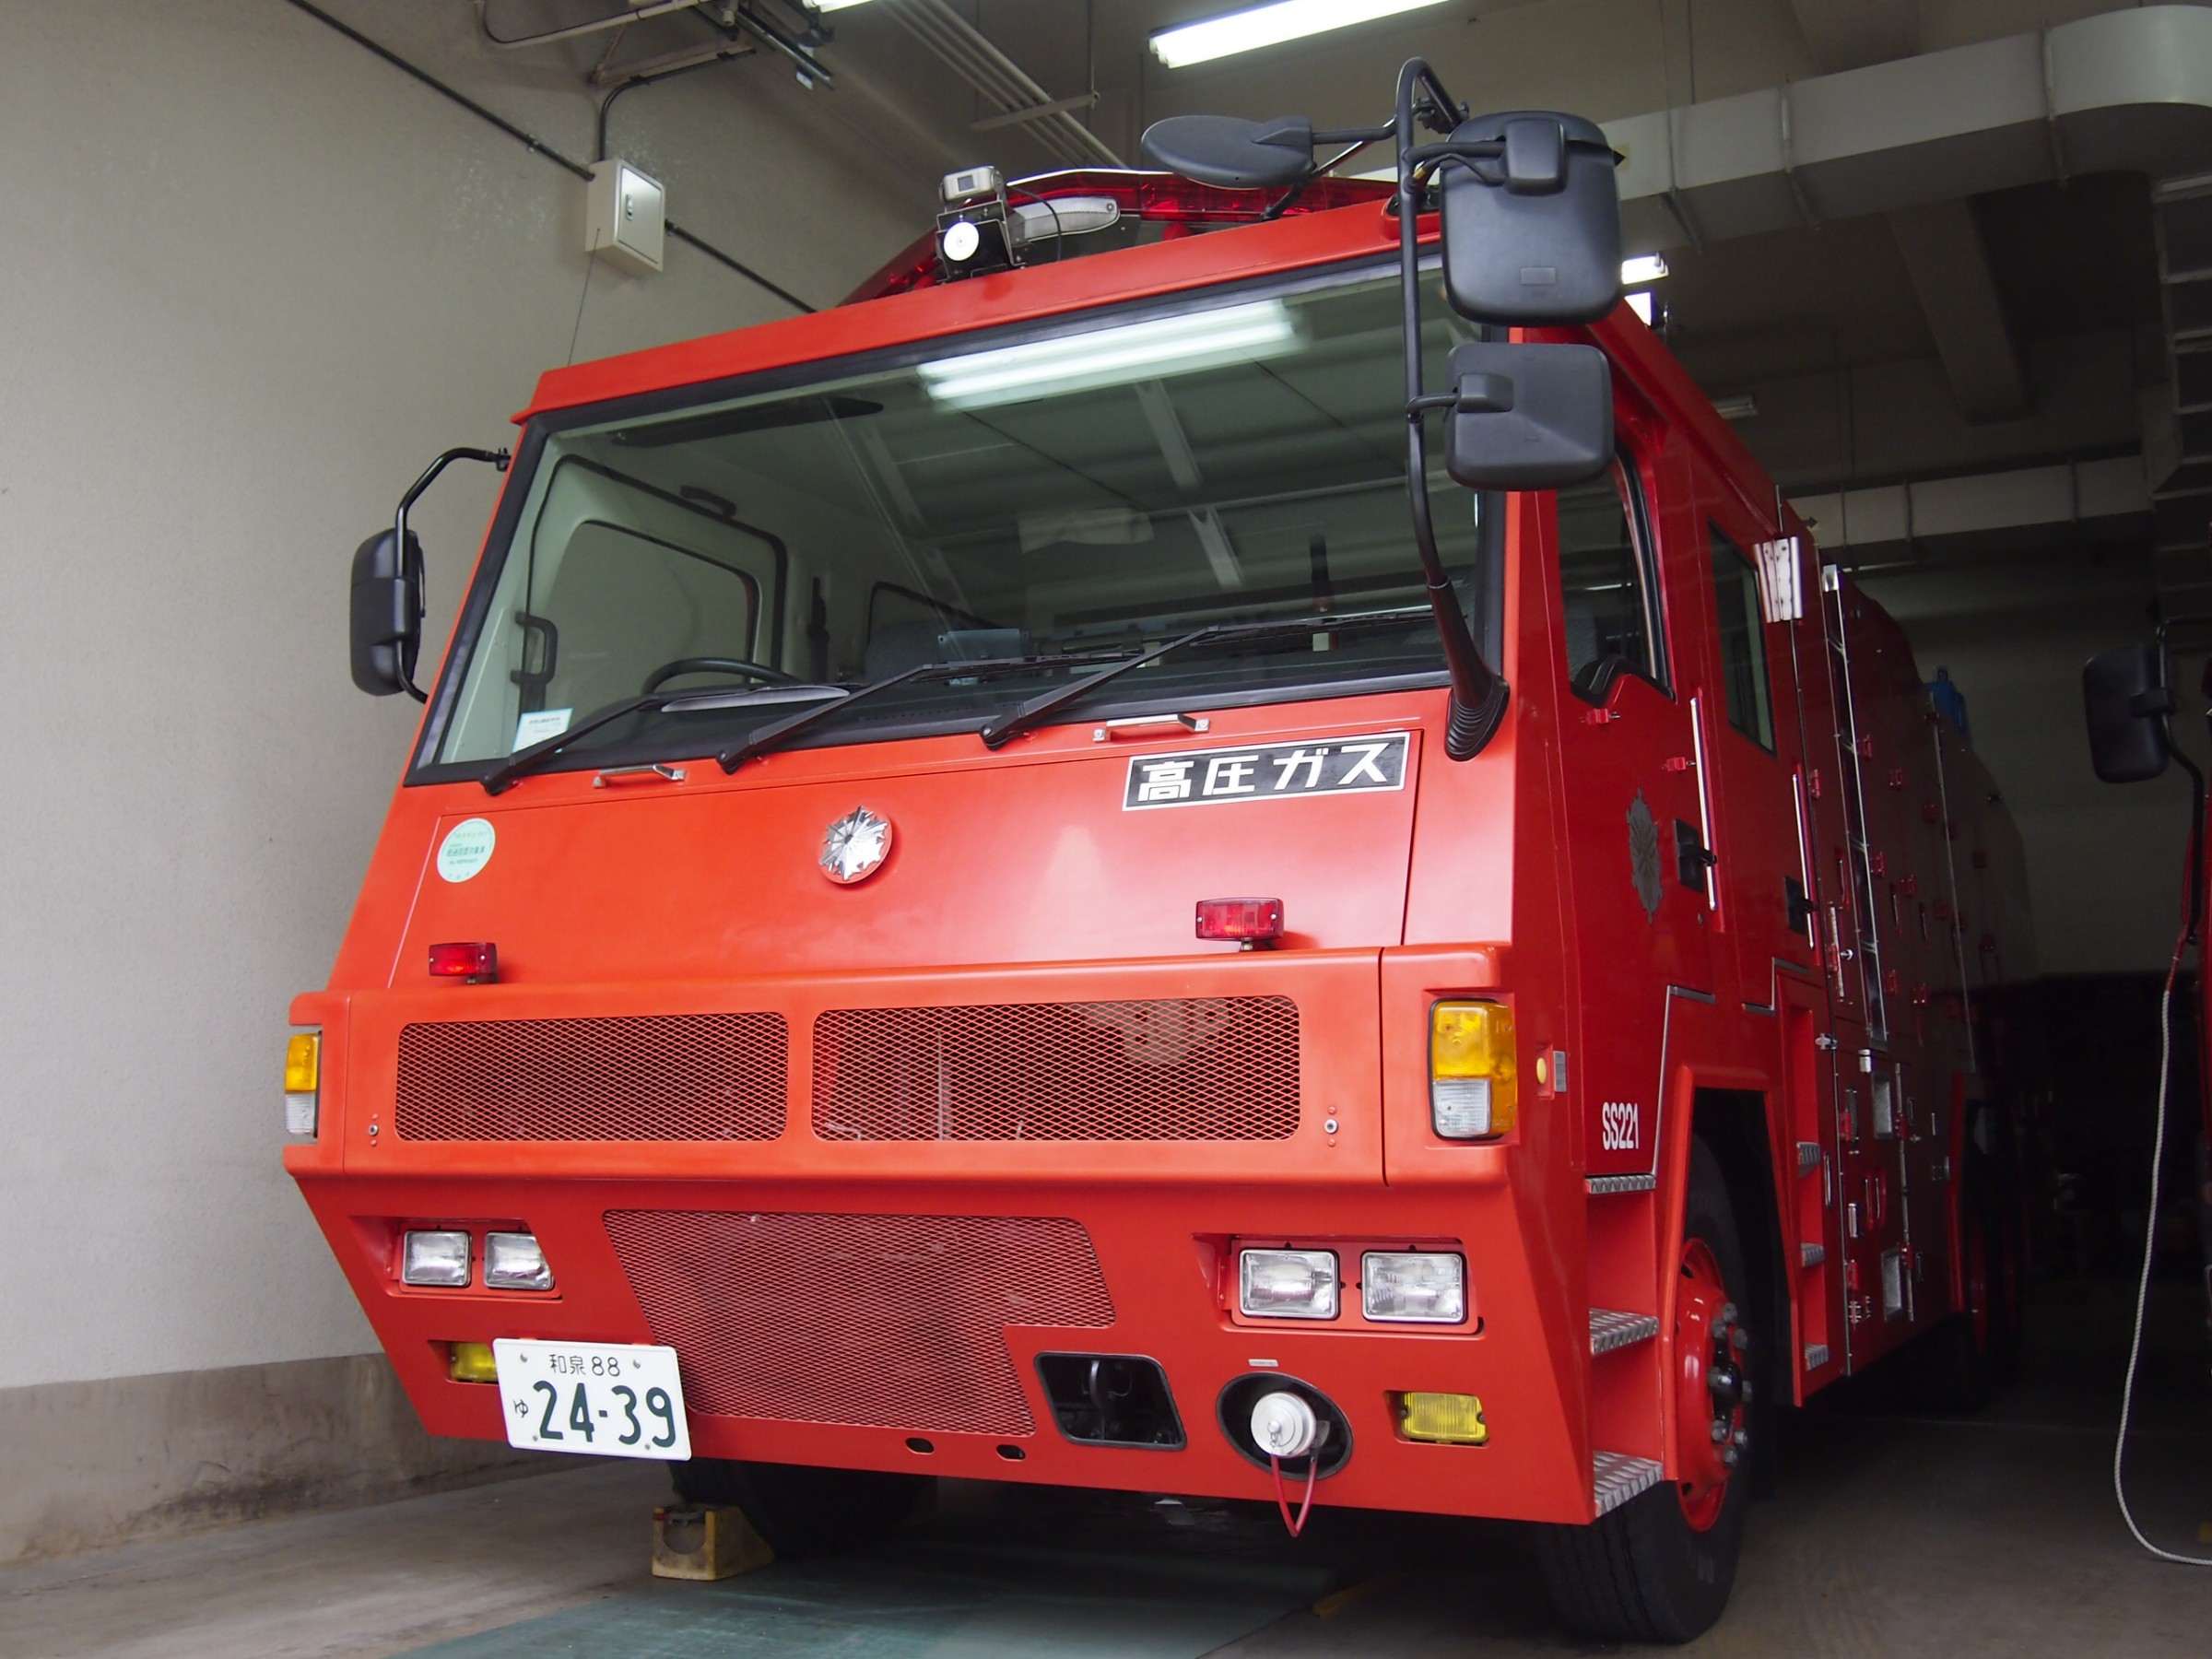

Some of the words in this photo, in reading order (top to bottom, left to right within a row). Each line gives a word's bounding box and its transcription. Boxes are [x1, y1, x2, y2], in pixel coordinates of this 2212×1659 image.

[1137, 742, 1391, 802] 高圧ガス
[1602, 1101, 1639, 1150] SS221
[512, 1399, 529, 1418] ゆ
[533, 1381, 677, 1448] 24-39
